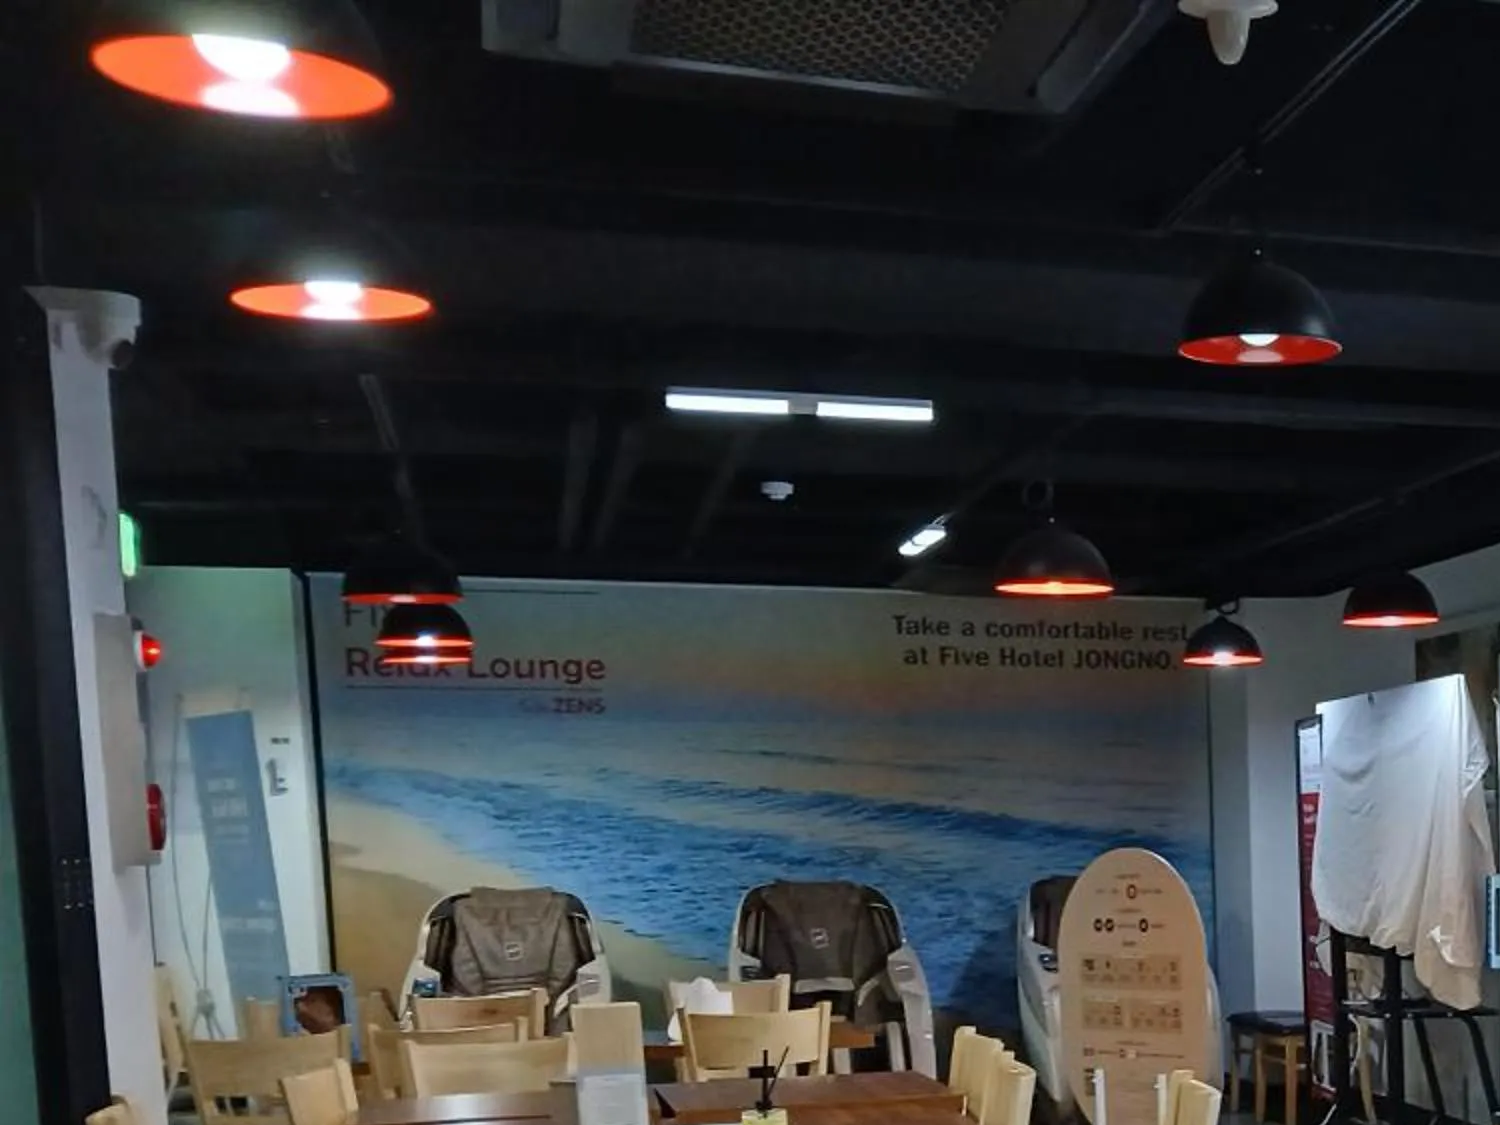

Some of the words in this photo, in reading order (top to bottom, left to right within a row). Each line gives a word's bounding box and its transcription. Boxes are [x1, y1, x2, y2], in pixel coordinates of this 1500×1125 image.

[892, 615, 950, 637] Take
[961, 620, 976, 637] a
[985, 615, 1135, 641] comfortable
[1142, 620, 1190, 642] rest
[467, 656, 607, 684] Lounge
[903, 647, 929, 667] at
[939, 646, 990, 668] Five
[999, 647, 1065, 669] Hotel
